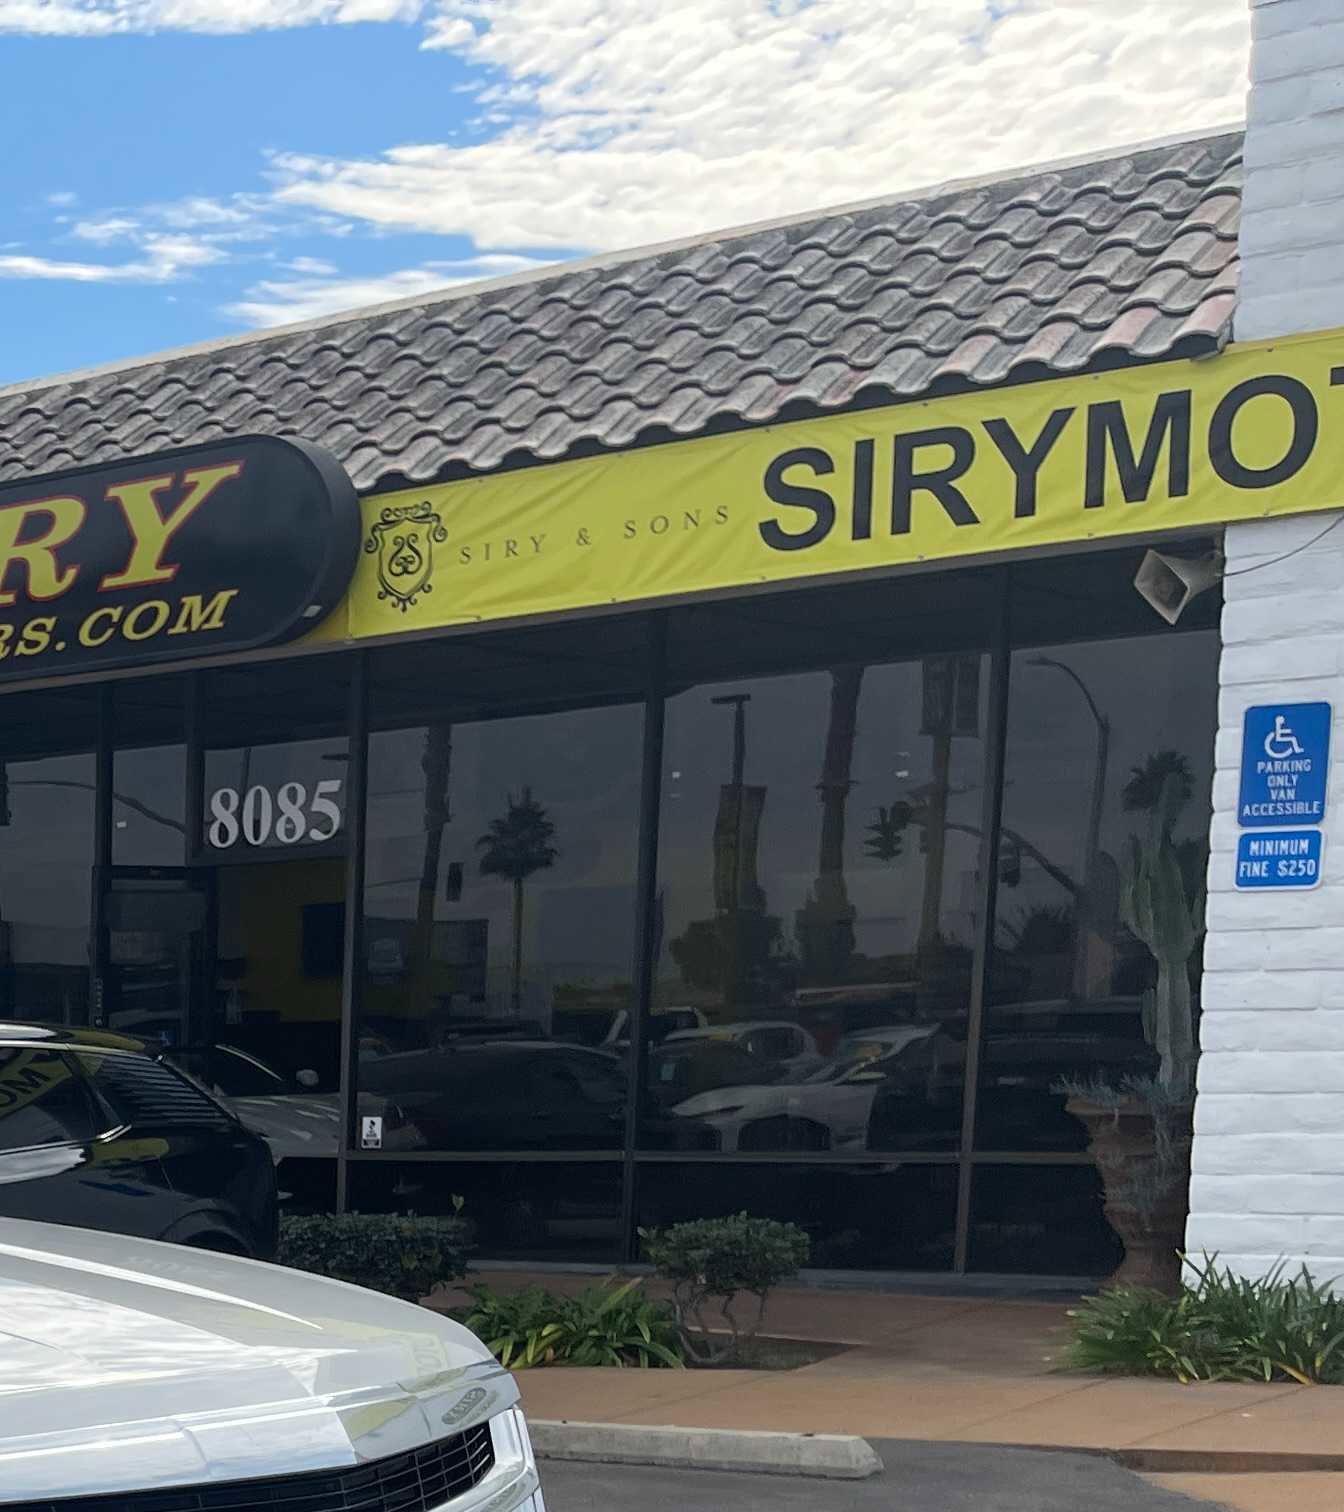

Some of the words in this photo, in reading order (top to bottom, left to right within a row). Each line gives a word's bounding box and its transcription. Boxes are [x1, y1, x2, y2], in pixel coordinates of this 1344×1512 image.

[758, 368, 1344, 552] SIRYMO
[459, 531, 548, 566] SIRY
[576, 528, 592, 548] &
[624, 502, 731, 541] SONS
[1257, 758, 1312, 774] PARKING
[1267, 774, 1299, 788] ONLY
[1270, 788, 1296, 801] VAN
[209, 779, 343, 849] 8085
[1242, 801, 1321, 817] ACCESSIBLE
[1249, 839, 1309, 857] MINIMUM
[1239, 860, 1270, 878] FINE
[1277, 859, 1316, 877] $250
